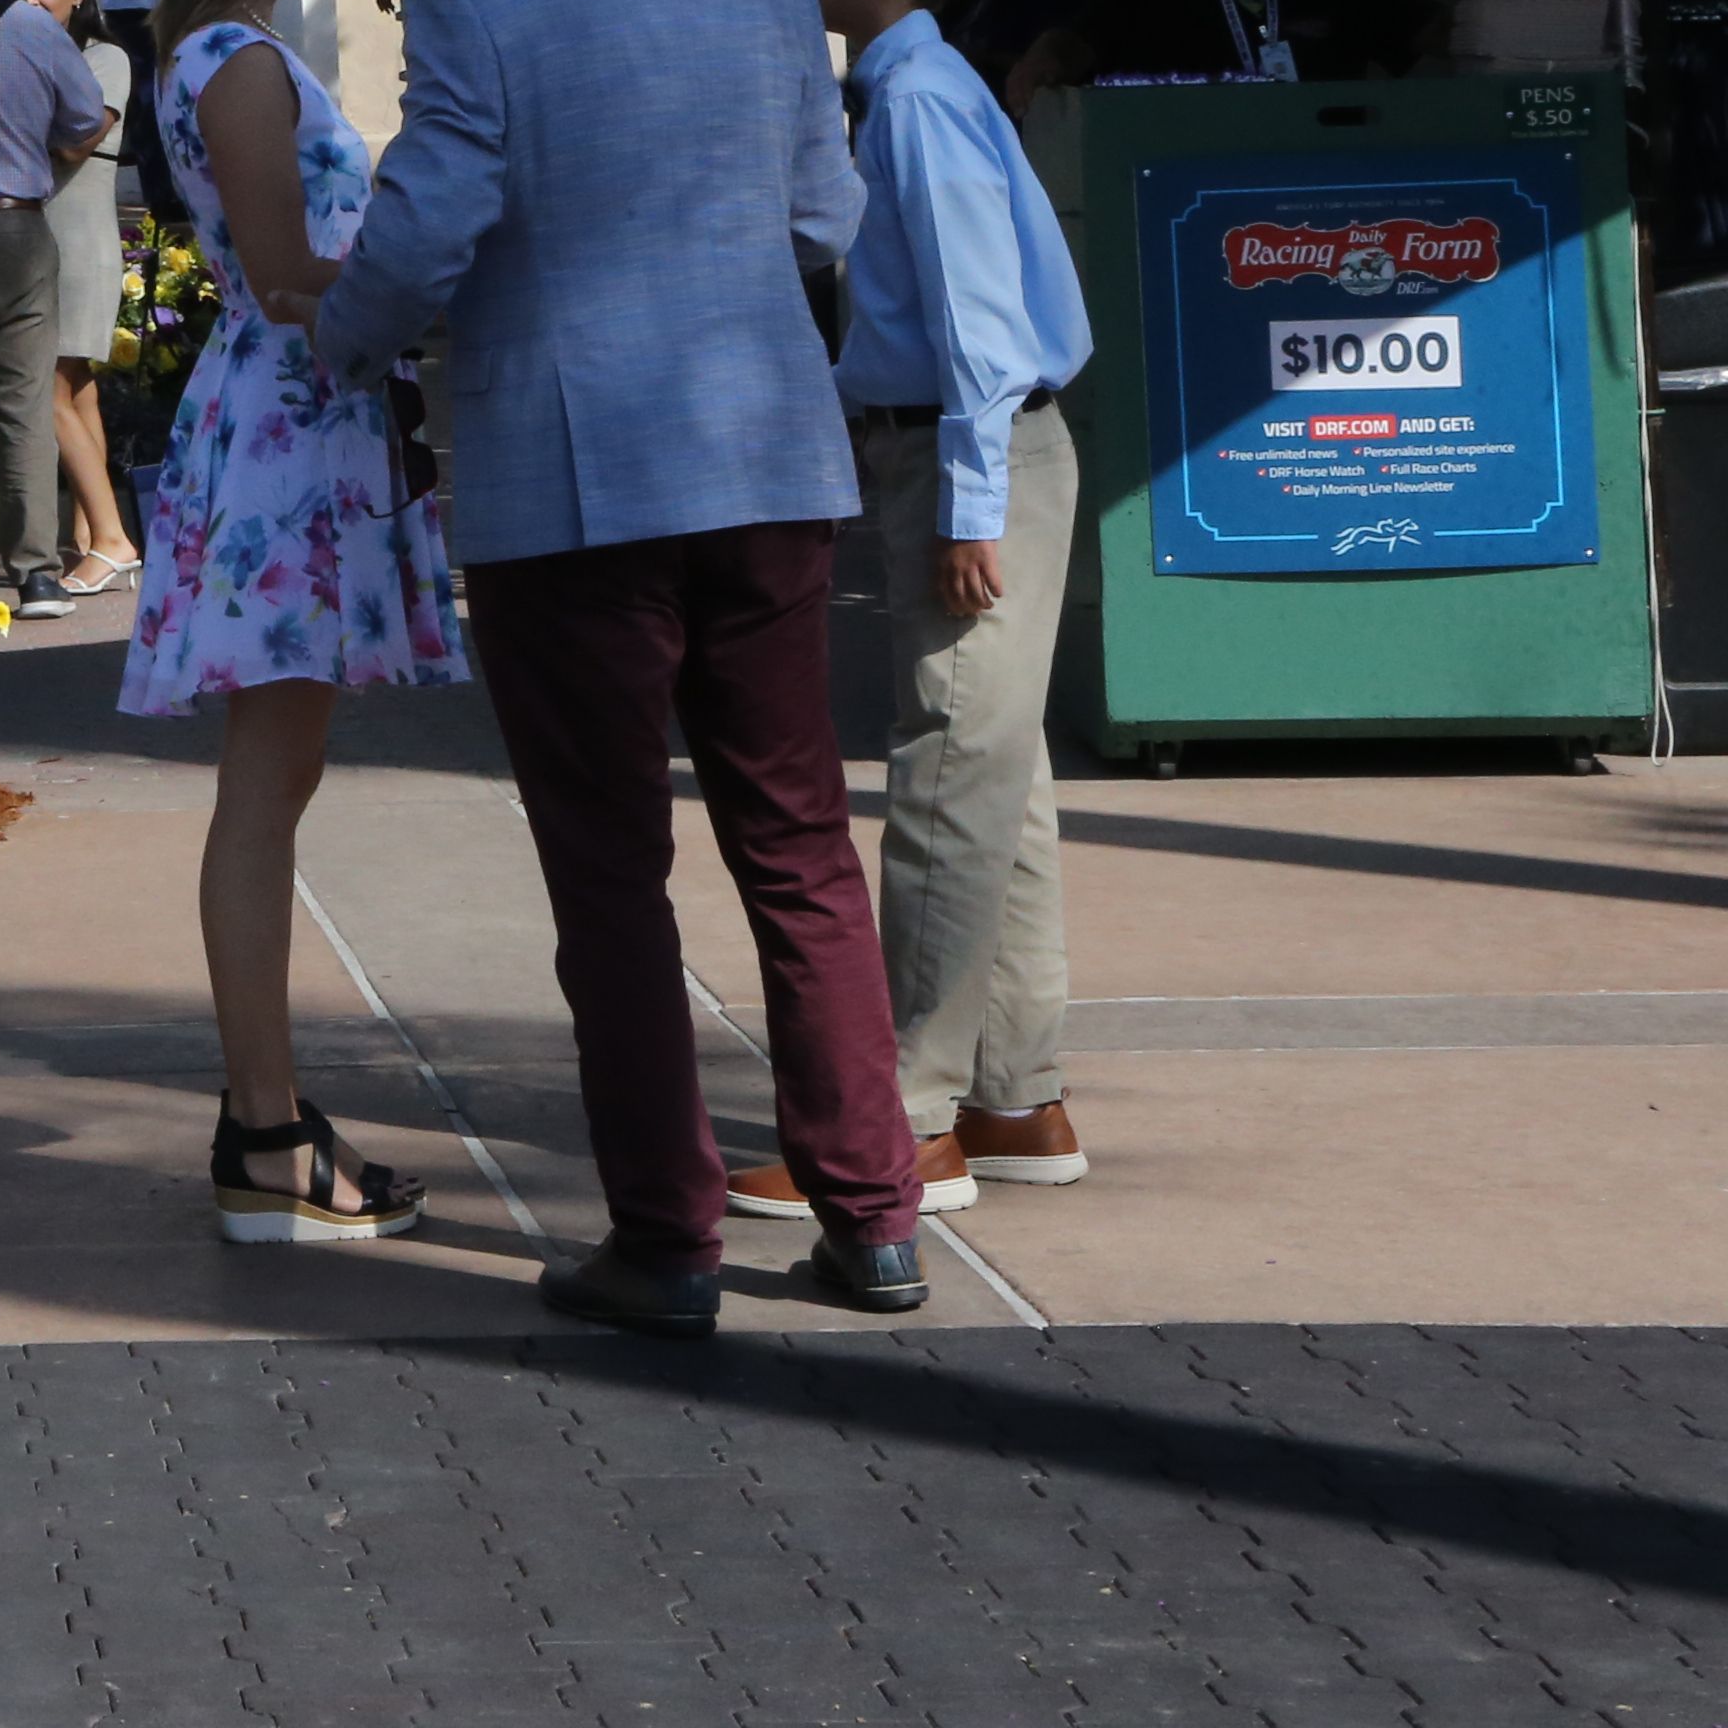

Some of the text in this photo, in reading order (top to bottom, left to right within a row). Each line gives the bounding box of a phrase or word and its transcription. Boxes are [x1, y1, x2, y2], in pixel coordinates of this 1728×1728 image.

[1520, 86, 1576, 104] PENS
[1526, 109, 1573, 127] $.50
[1239, 229, 1482, 269] Racing Daily Form
[1280, 331, 1450, 377] $10.00
[1263, 417, 1475, 437] VISIT DRF.COM AND GET:
[1229, 448, 1338, 460] Free unlimited news
[1363, 443, 1515, 458] Personalized site experience
[1268, 466, 1365, 478] DRF Horse Watch
[1390, 462, 1477, 475] Full Race Charts
[1292, 481, 1455, 497] Daily Morning Line Newsletter
